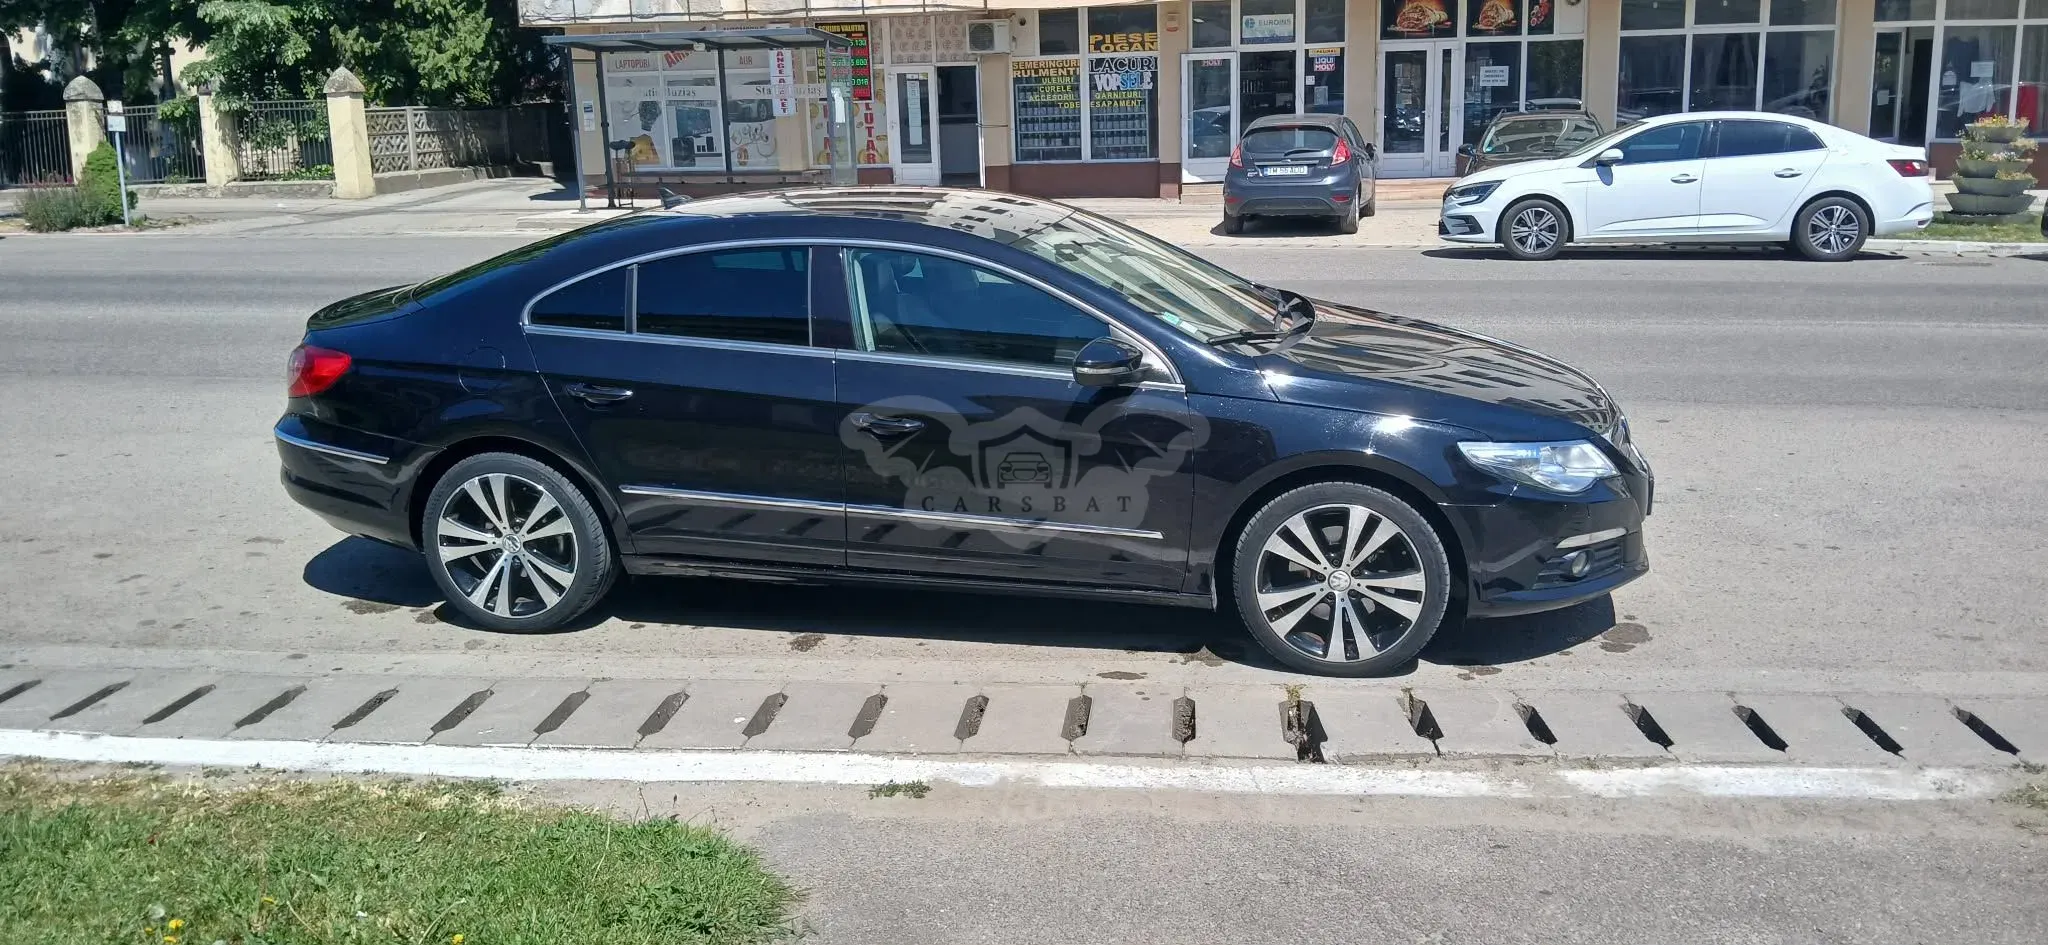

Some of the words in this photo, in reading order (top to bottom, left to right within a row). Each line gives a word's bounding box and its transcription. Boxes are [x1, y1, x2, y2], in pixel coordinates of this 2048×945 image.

[1090, 32, 1158, 44] PIESE
[1089, 42, 1158, 53] LOGAN
[1012, 59, 1080, 70] SEMERINGURI
[1088, 56, 1158, 73] LACURI
[1315, 63, 1335, 71] MOLY
[1041, 76, 1074, 84] ULEIURI
[1094, 70, 1154, 92] VOPSELE
[1095, 91, 1141, 99] GARNITURI
[1090, 99, 1142, 107] ESAPAMENT
[864, 102, 876, 164] LUTAR
